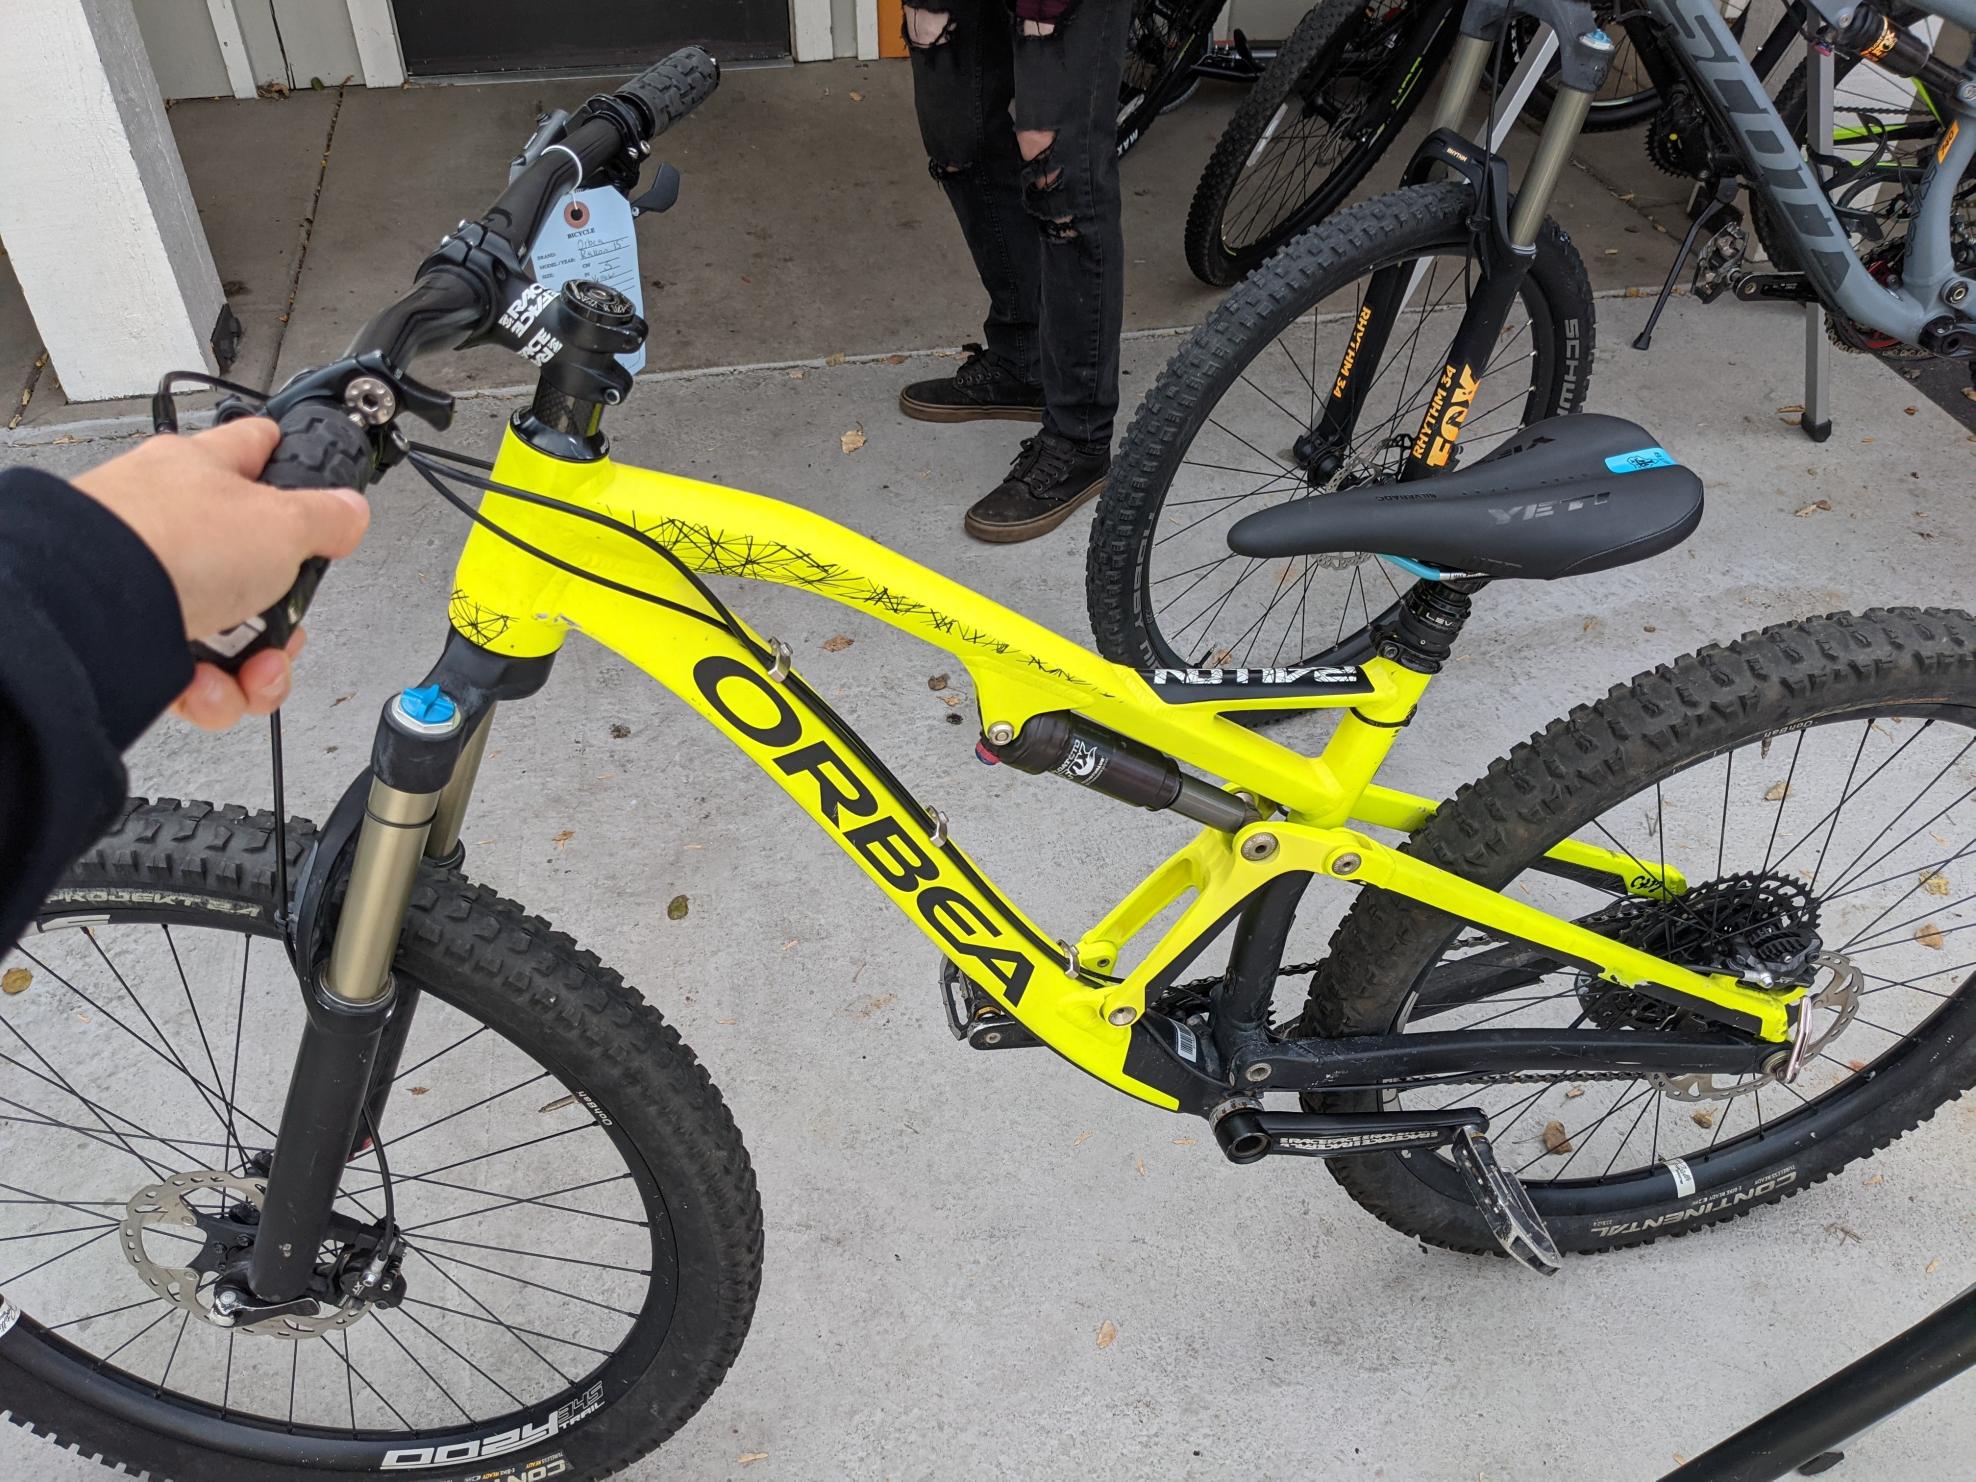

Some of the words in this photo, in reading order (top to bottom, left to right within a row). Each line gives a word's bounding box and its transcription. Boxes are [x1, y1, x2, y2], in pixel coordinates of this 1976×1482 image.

[1116, 128, 1139, 157] MAX
[567, 227, 595, 239] BICYCLE
[1341, 306, 1372, 377] RHYTHM
[1556, 318, 1580, 416] SCHW
[1333, 377, 1347, 399] 34
[1412, 389, 1448, 459] RHYTHM
[1441, 364, 1457, 387] 34
[1426, 363, 1481, 467] FOX
[1488, 491, 1611, 525] YETI
[692, 656, 1036, 1009] ORBEA
[1590, 1171, 1797, 1238] CONTINENTAL
[557, 1380, 603, 1423] 345
[558, 1401, 605, 1430] TRAIL
